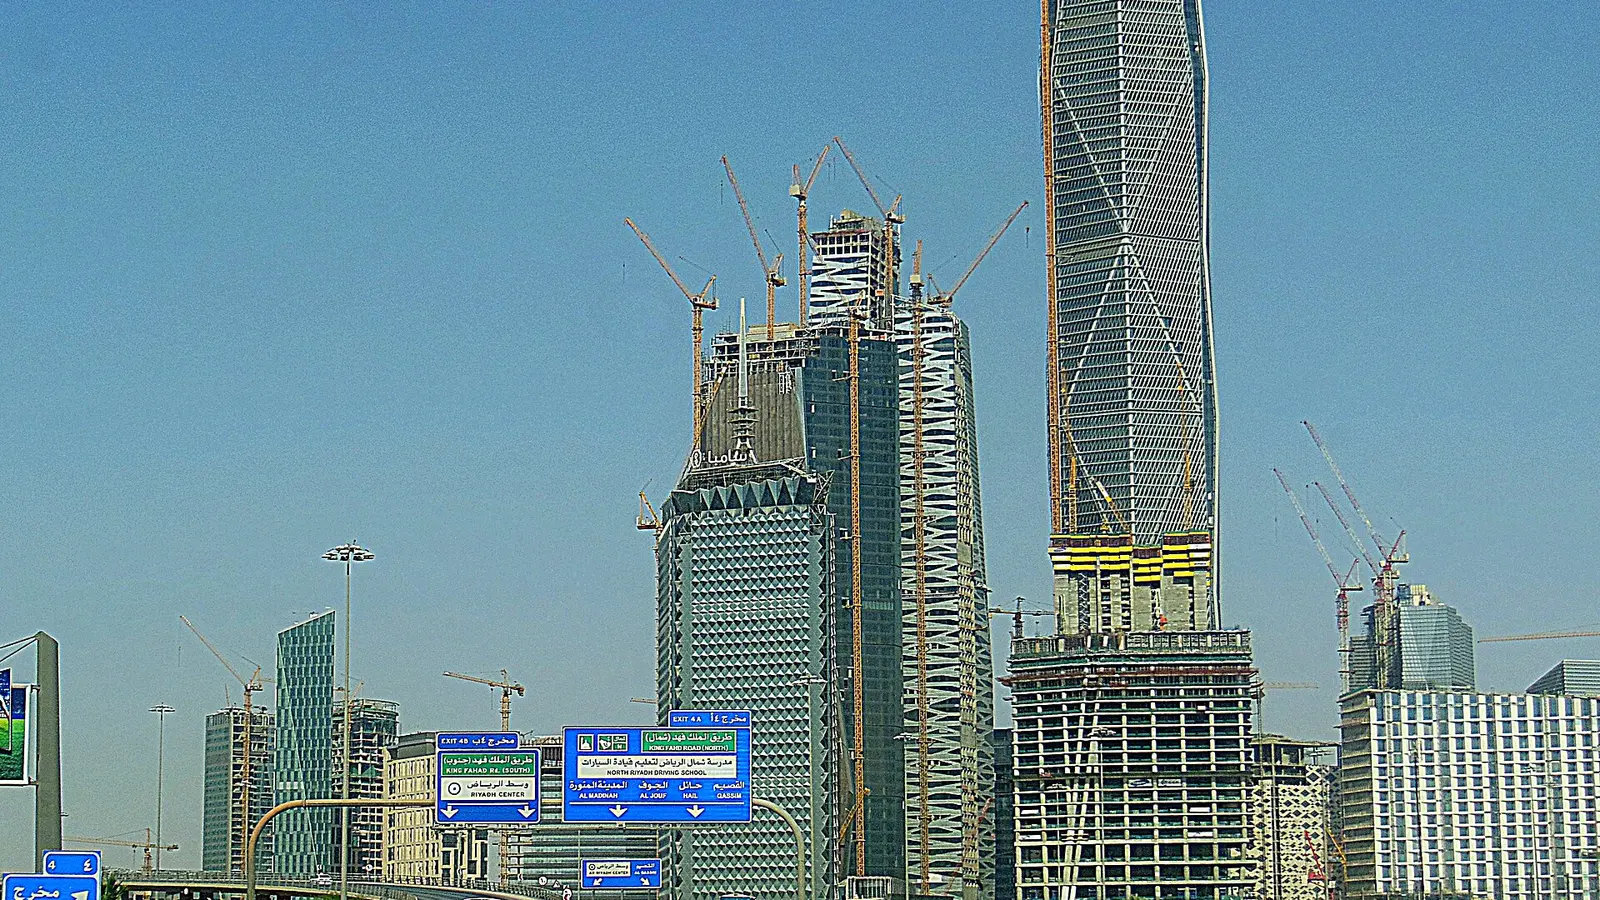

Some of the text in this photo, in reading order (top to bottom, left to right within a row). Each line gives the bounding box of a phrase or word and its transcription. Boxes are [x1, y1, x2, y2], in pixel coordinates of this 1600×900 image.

[722, 714, 747, 724] مخرج
[488, 737, 515, 747] مخرج
[672, 733, 686, 742] فهد
[687, 733, 709, 741] الملك
[709, 733, 732, 743] طريق
[443, 756, 533, 765] طريق الملك فهد (جنوب)
[581, 758, 733, 767] مدرسة شمال الرياض لتعليم قيادة السيارات
[466, 780, 529, 790] وسط الرياض
[569, 780, 628, 790] المدينة المنورة
[638, 781, 669, 791] الجوف
[678, 781, 702, 791] حائل
[713, 781, 745, 791] القصيم
[48, 860, 56, 870] 4
[13, 886, 60, 900] مخرج
